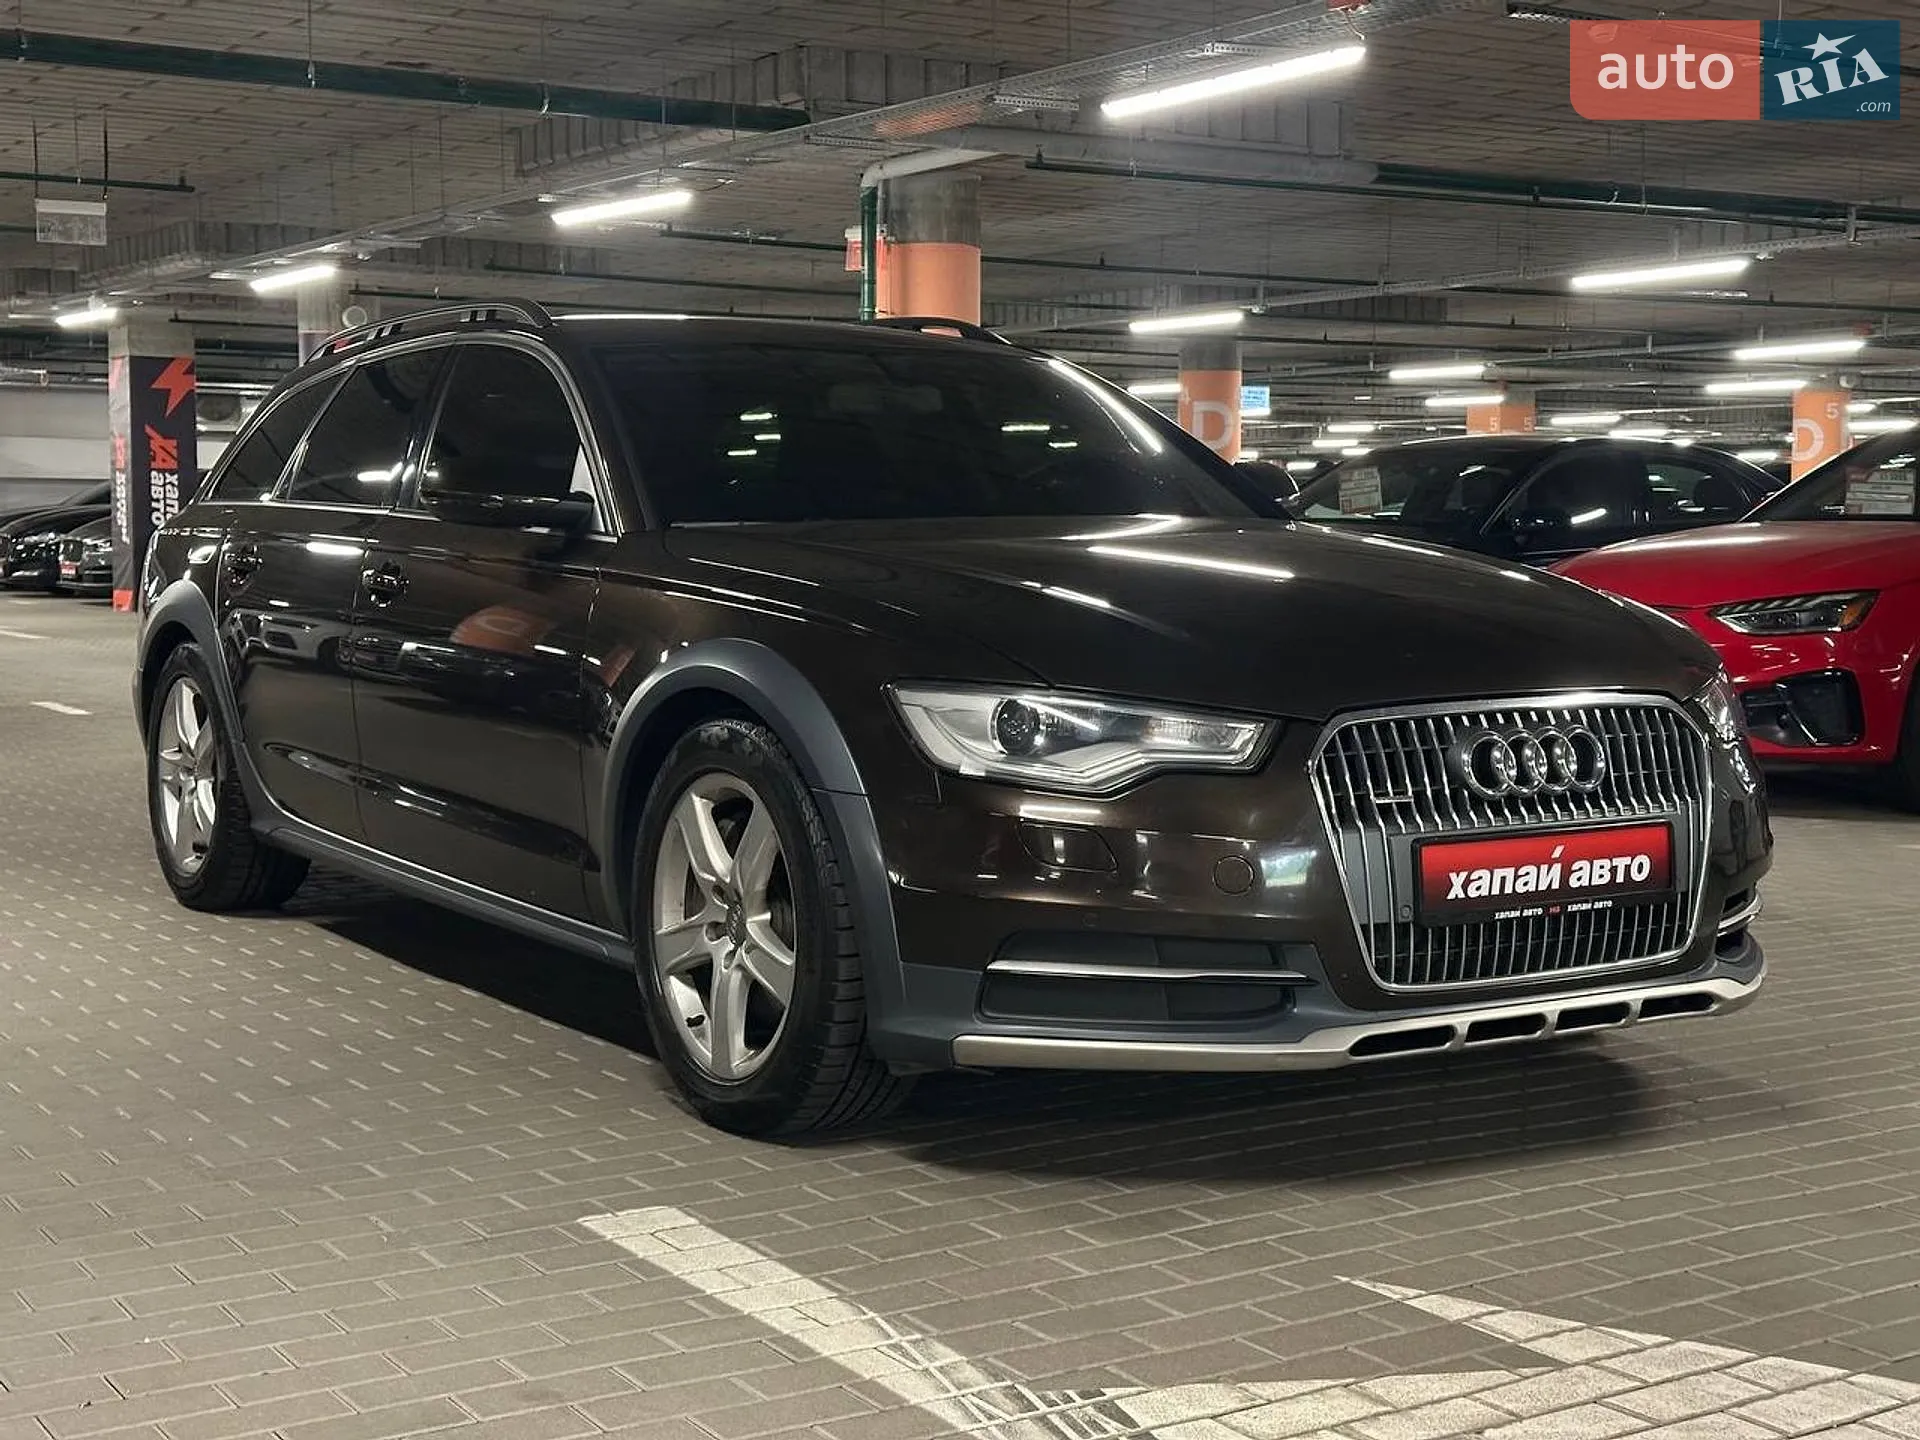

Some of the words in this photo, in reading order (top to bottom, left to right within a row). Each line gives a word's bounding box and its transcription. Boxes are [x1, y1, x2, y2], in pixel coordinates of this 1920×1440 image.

[1192, 401, 1233, 451] D
[1825, 402, 1840, 419] 5
[1792, 418, 1825, 462] D
[151, 470, 164, 526] авто
[1569, 854, 1651, 889] авто
